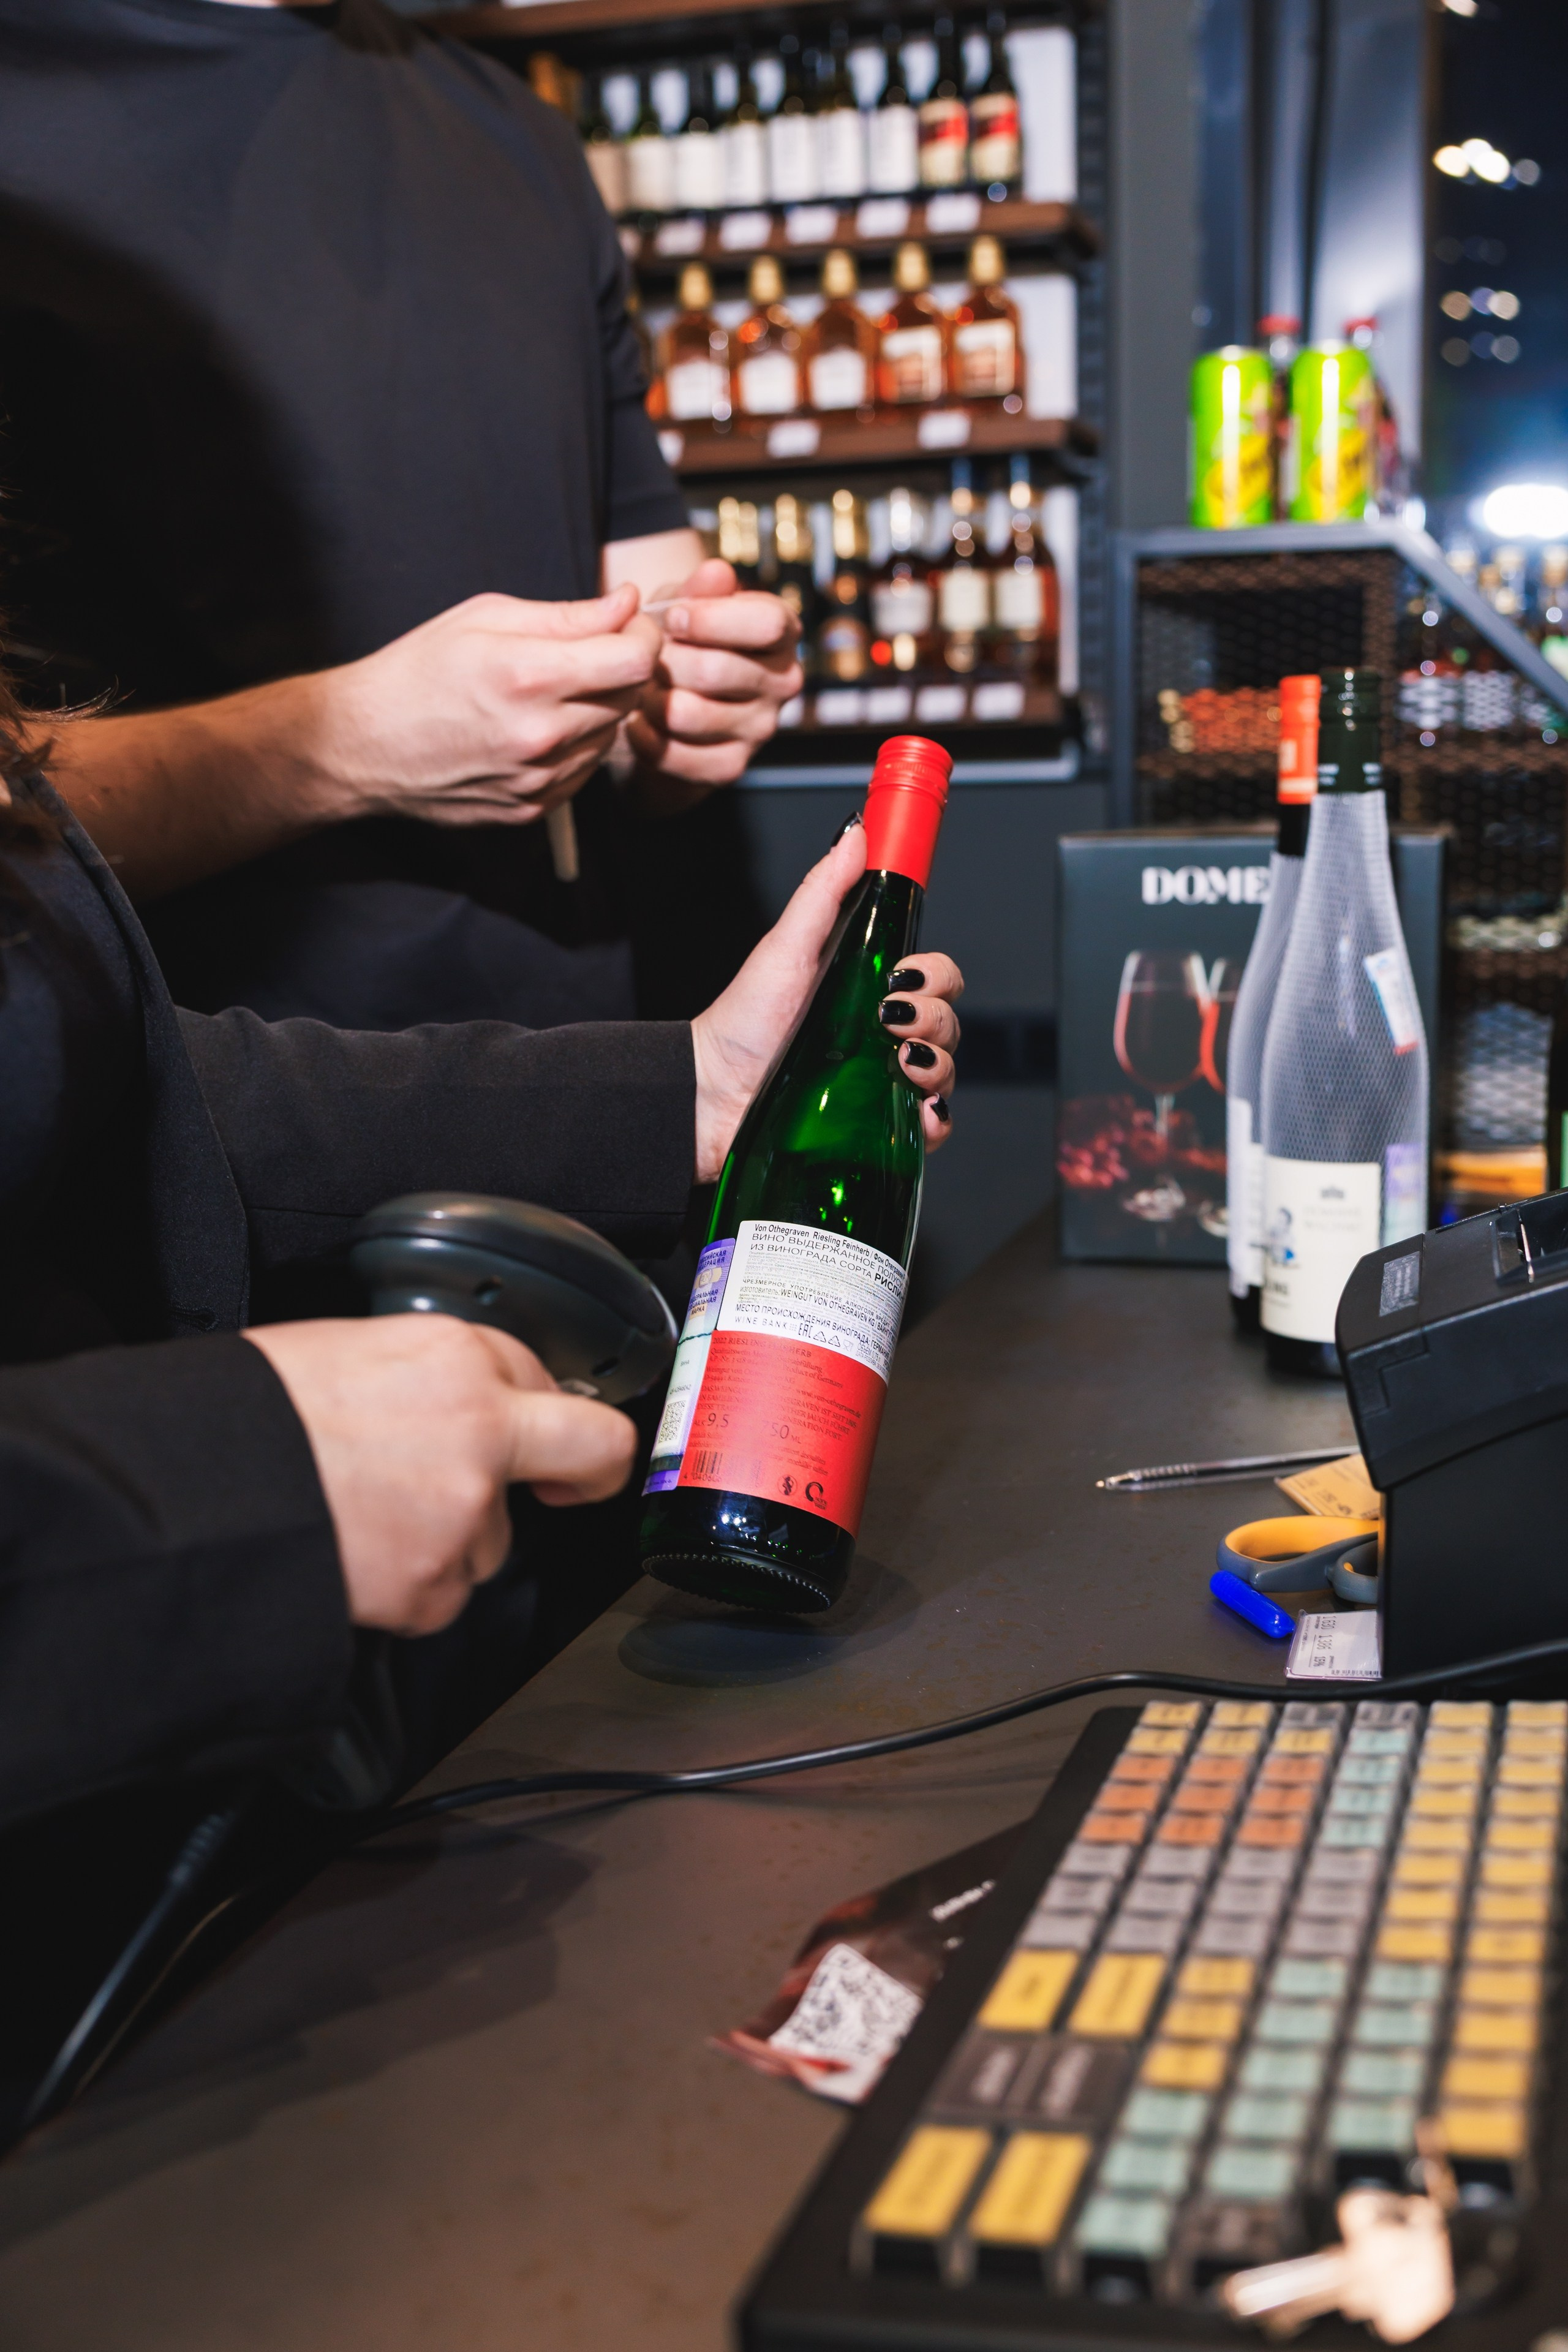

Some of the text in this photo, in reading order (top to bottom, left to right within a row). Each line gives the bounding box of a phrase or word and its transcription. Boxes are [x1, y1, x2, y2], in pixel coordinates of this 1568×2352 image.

[769, 1224, 809, 1237] Othegraven
[813, 1231, 840, 1248] Riesling
[842, 1240, 870, 1256] Feinherb
[874, 1253, 884, 1263] Фон
[752, 1234, 785, 1242] ВИНО
[788, 1236, 876, 1270] ВЫДЕРЖАННОЕ
[767, 1244, 837, 1265] ВИНОГРАДА
[840, 1260, 872, 1278] СОРТА
[742, 1278, 786, 1288] ЧРЕЗМЕРНОЕ
[790, 1284, 842, 1303] УПОТРЕБЛЕНИЕ
[845, 1300, 874, 1316] АЛКОГОЛЯ
[875, 1314, 890, 1327] ВРЕДИТ
[781, 1289, 813, 1302] WEINGUT
[814, 1295, 827, 1306] VON
[829, 1300, 867, 1323] OTHEGRAVEN
[868, 1316, 875, 1327] KG
[735, 1316, 758, 1325] WINE
[763, 1318, 787, 1329] BANK
[736, 1303, 760, 1313] МЕСТО
[761, 1306, 831, 1328] ПРОИСХОЖДЕНИЯ
[832, 1322, 871, 1344] ВИНОГРАДА:
[728, 1338, 766, 1349] RIESLING
[817, 1374, 843, 1389] Germany
[707, 1412, 729, 1428] 9,5
[807, 1412, 829, 1425] JAUCH
[821, 1408, 831, 1417] IST
[832, 1411, 845, 1422] SEIT
[790, 1434, 802, 1444] ML
